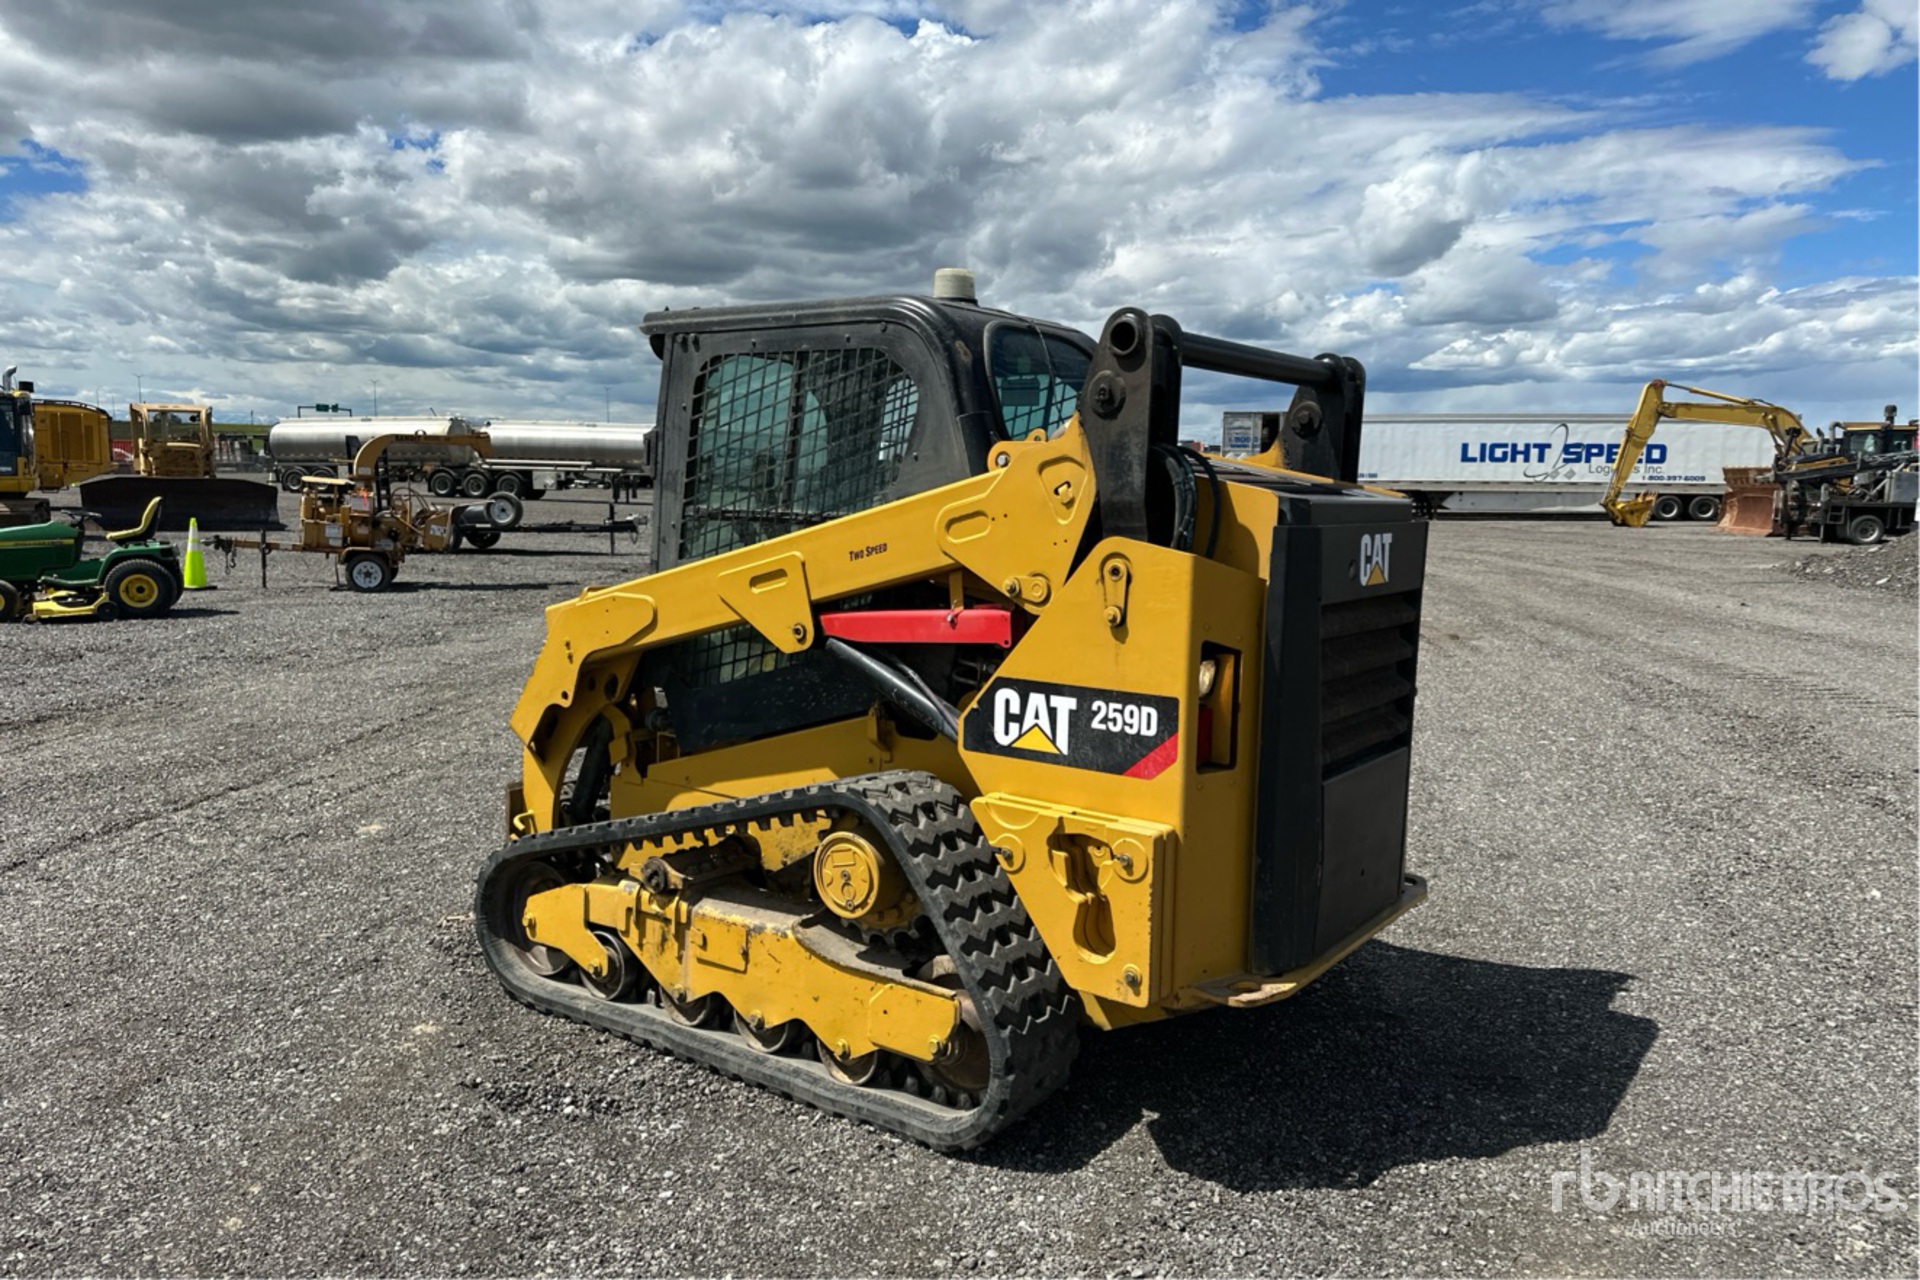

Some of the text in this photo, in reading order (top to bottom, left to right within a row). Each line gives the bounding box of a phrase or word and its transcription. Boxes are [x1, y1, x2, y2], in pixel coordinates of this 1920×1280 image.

[1461, 443, 1668, 464] LIGHT SPED
[1360, 533, 1392, 587] CAT
[993, 687, 1159, 756] CAT 259D
